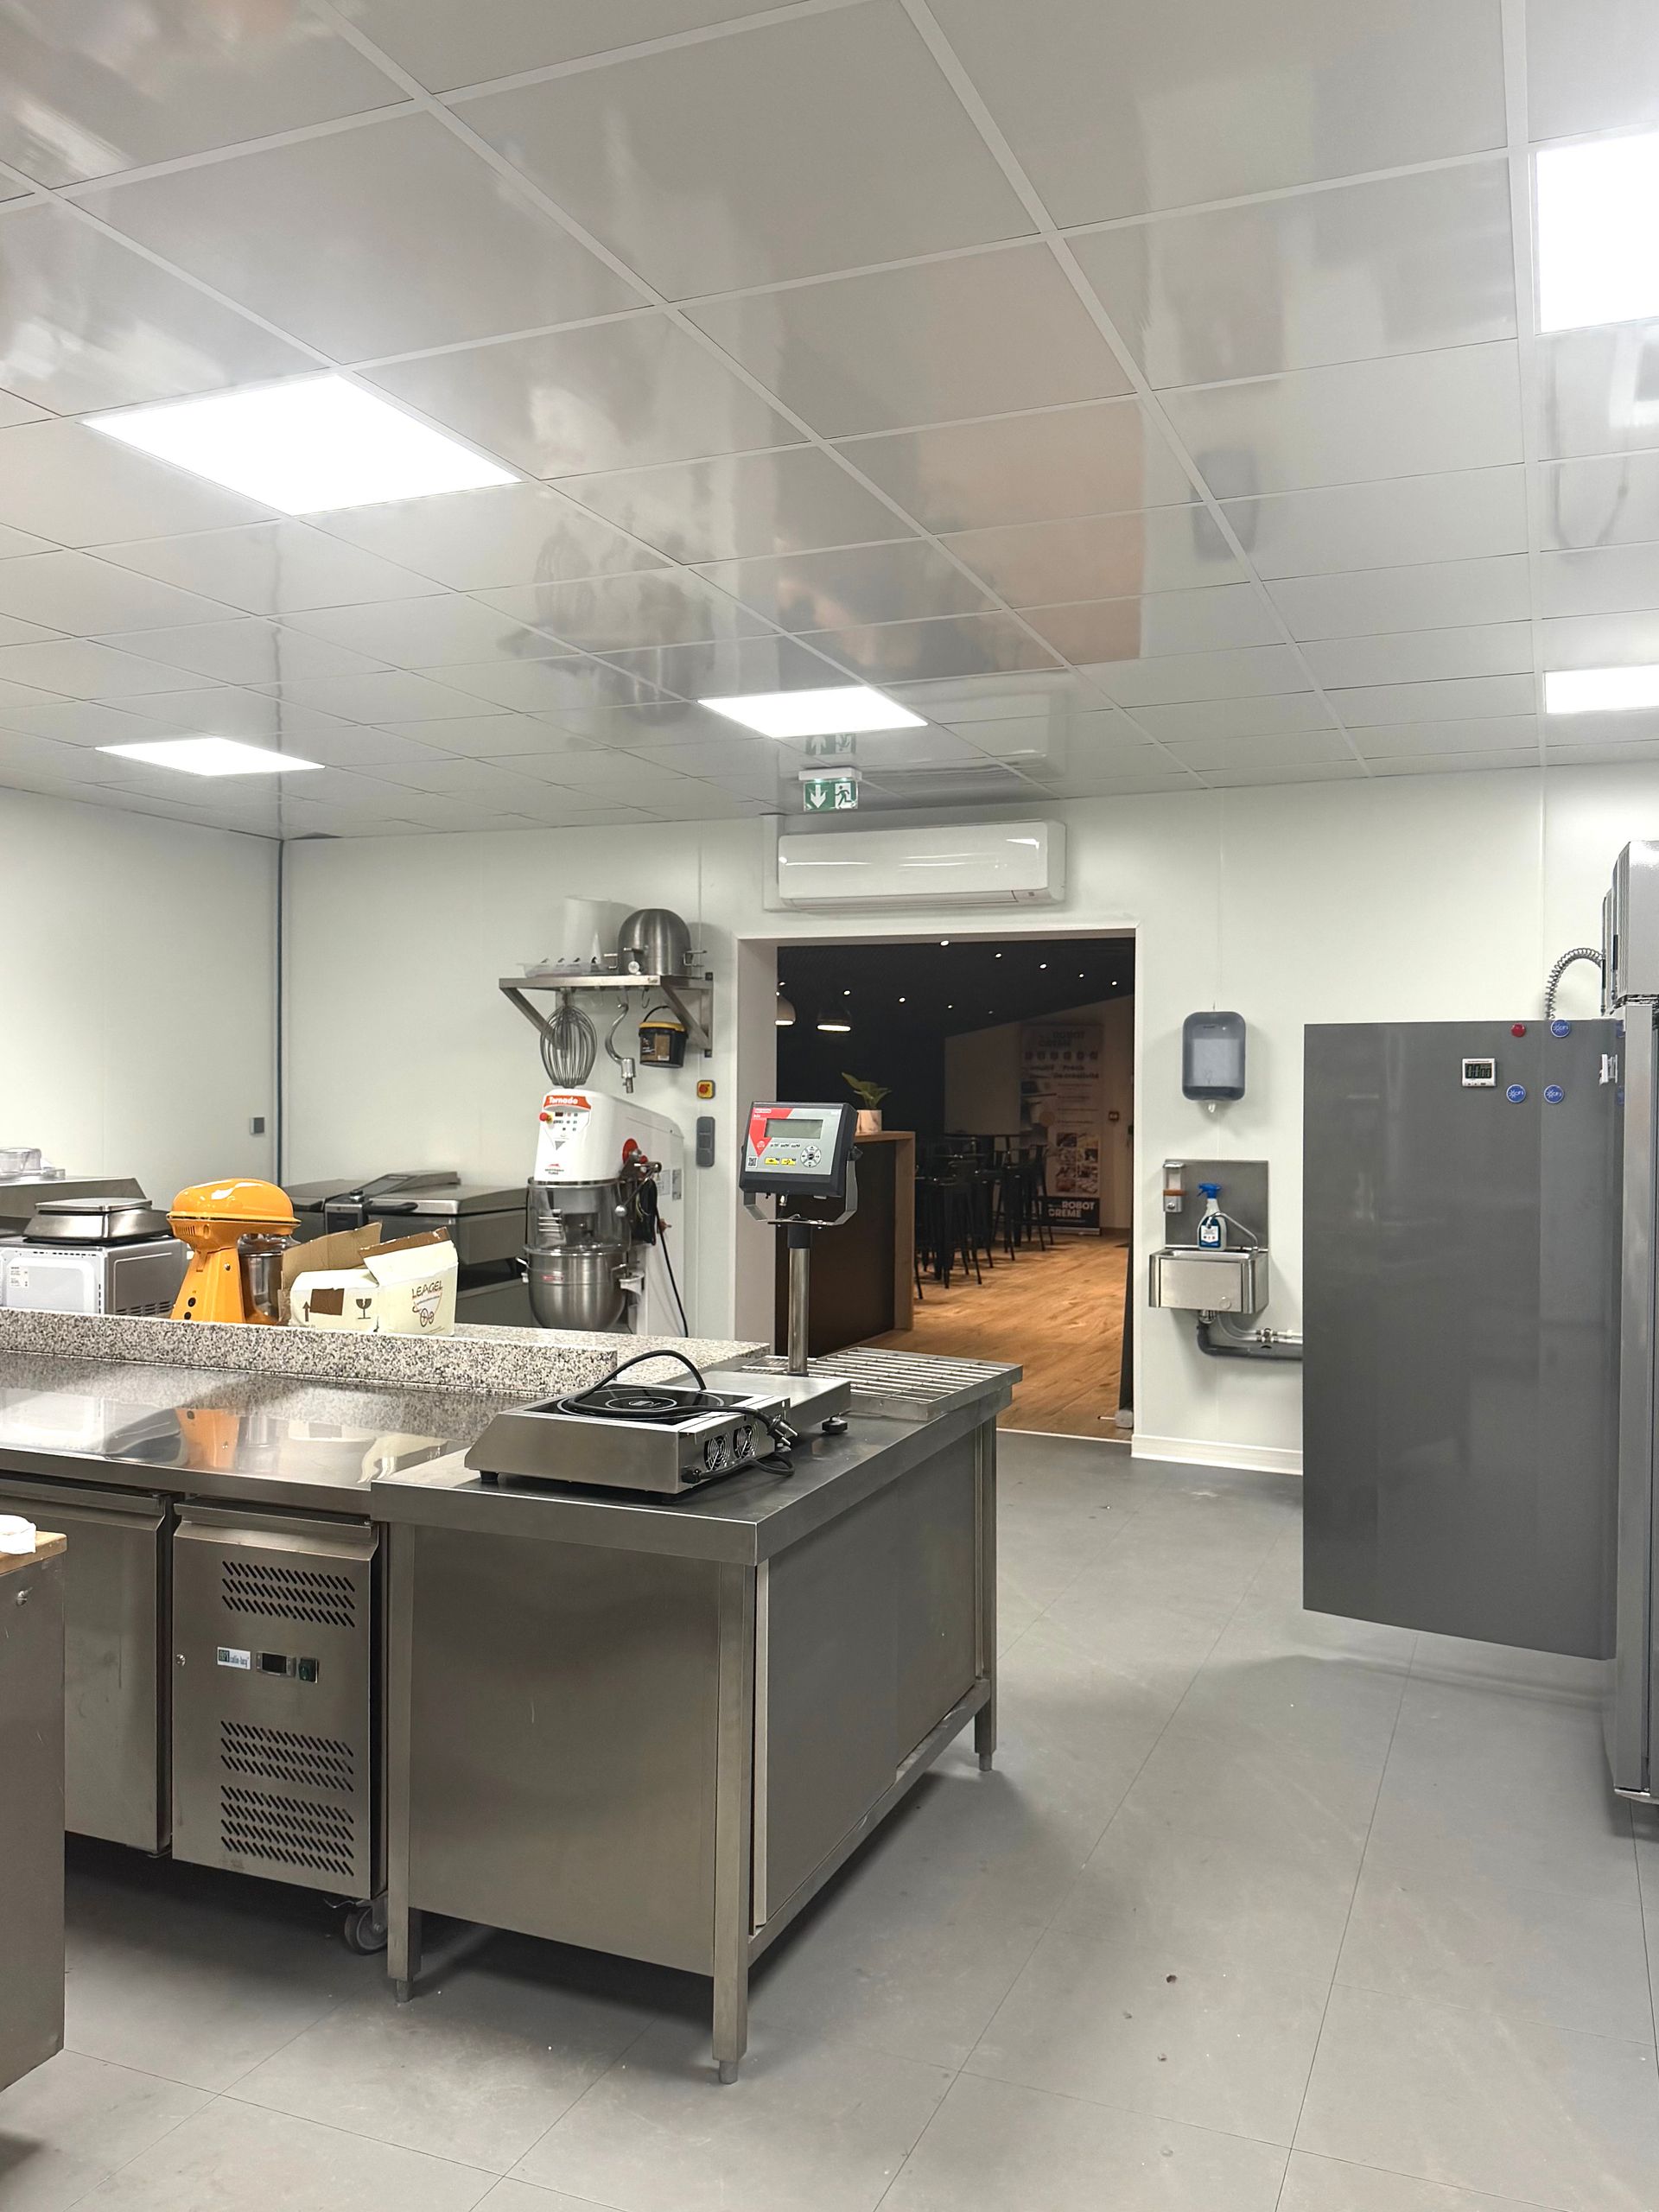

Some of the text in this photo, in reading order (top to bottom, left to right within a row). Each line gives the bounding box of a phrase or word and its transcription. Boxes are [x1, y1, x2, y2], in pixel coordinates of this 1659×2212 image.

[549, 1096, 578, 1105] Tornado
[1061, 1201, 1095, 1211] ROBOT
[412, 1280, 442, 1298] LEAGEL
